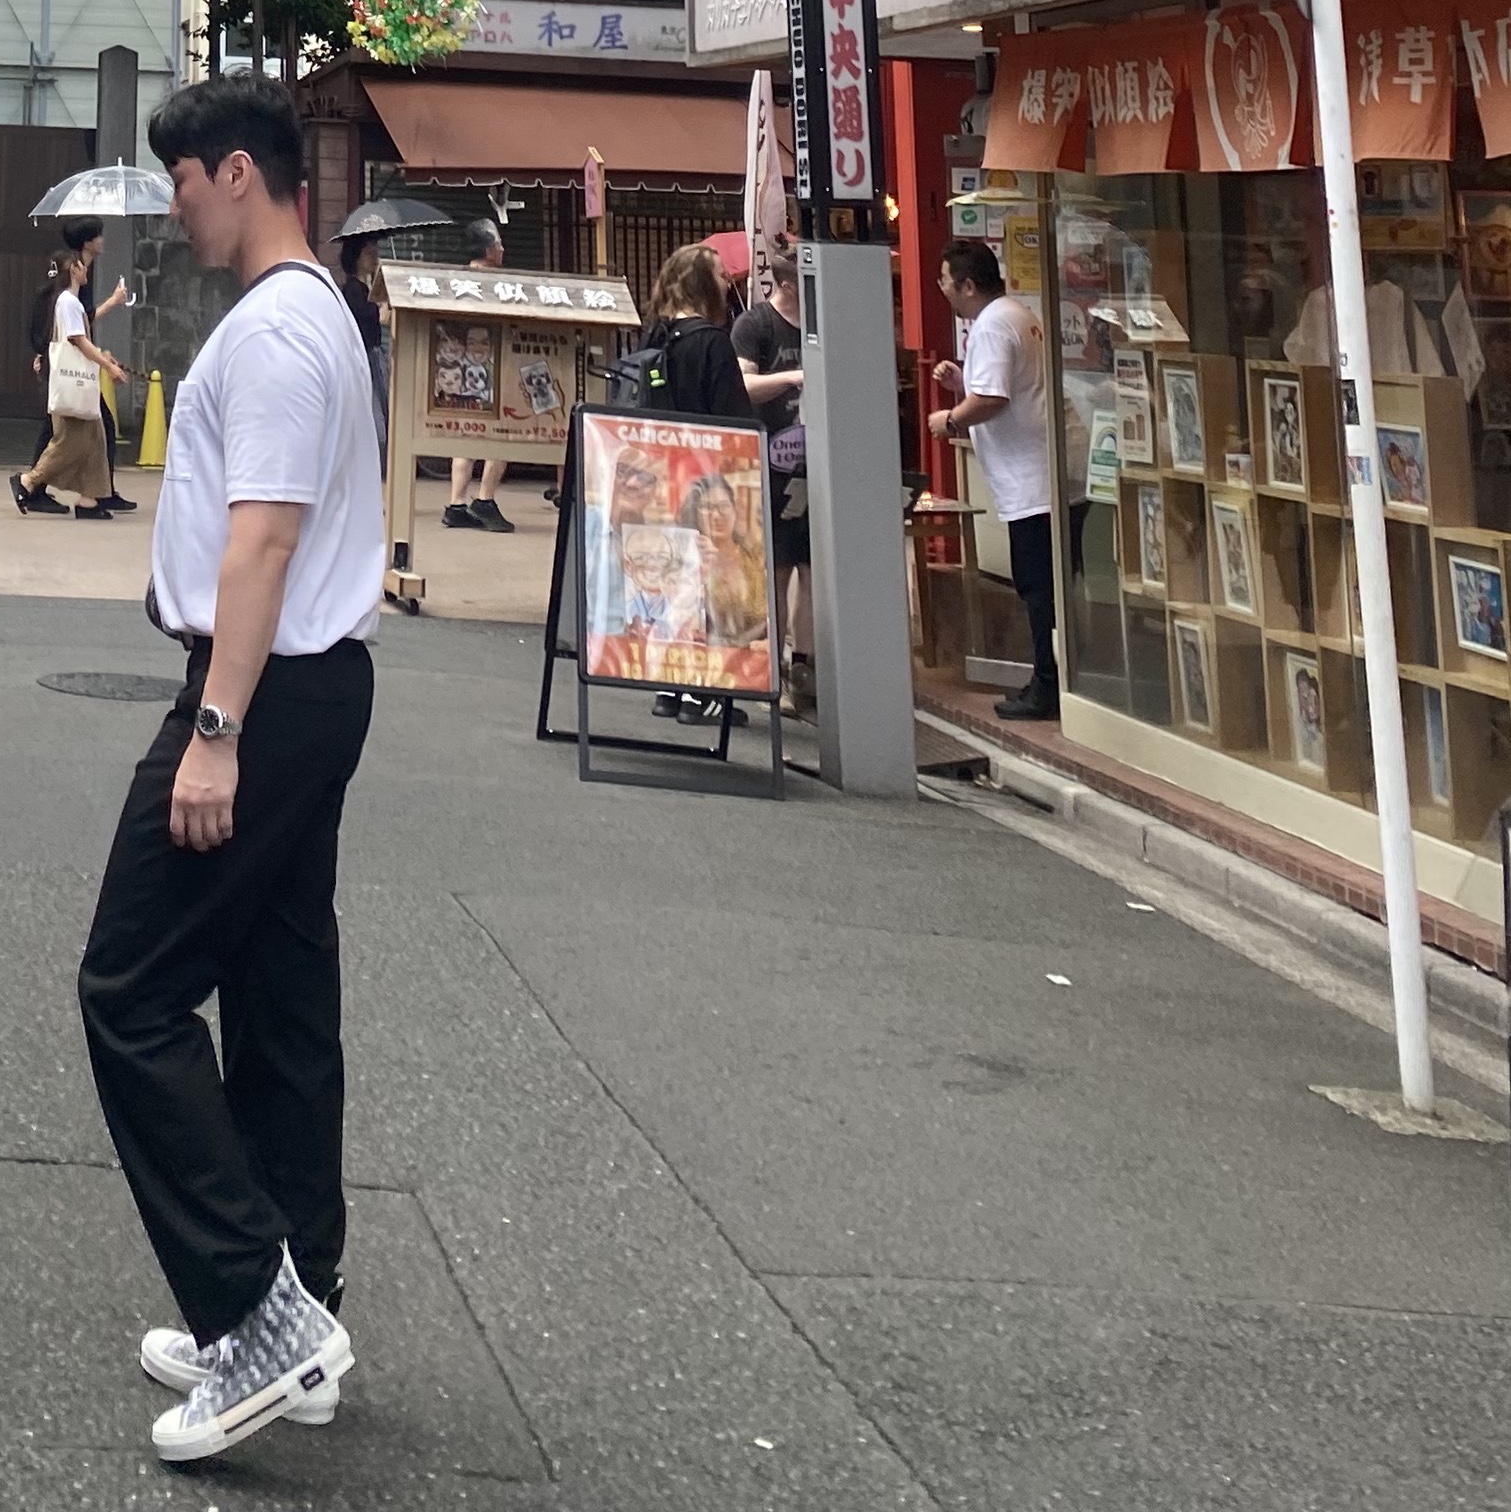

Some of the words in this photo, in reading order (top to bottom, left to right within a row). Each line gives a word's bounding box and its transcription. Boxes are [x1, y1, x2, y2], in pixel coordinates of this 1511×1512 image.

[537, 8, 629, 52] 和屋
[795, 77, 809, 150] DORI
[616, 424, 724, 452] CARICATURE
